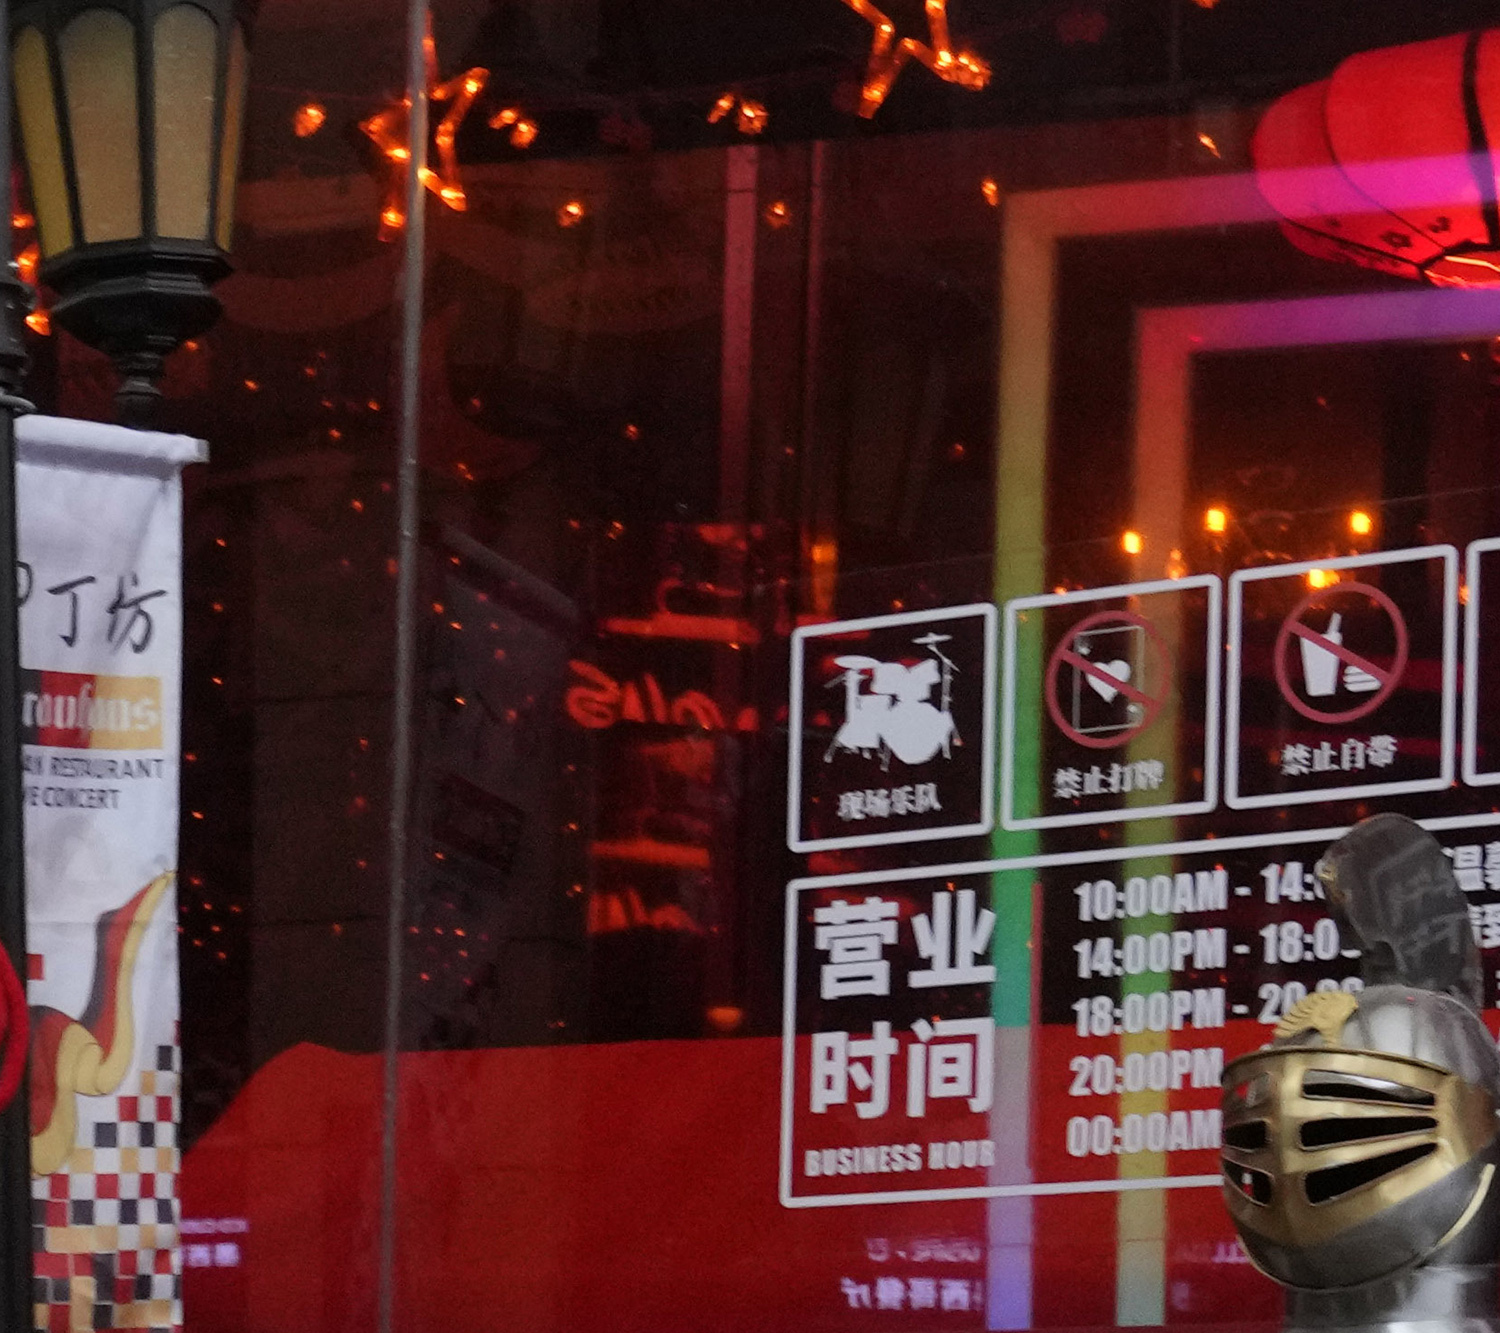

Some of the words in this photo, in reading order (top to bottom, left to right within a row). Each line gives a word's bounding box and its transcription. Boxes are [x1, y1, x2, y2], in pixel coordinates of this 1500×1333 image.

[1053, 759, 1165, 799] 禁止打牌
[1281, 734, 1398, 776] 禁止自带
[1075, 869, 1229, 922] 10:00AM
[1263, 861, 1326, 904] 14:
[814, 889, 998, 1000] 营业
[1073, 928, 1228, 980] 14:00PM
[1261, 917, 1362, 964] 18:0
[1071, 986, 1226, 1038] 18:00PM
[809, 1015, 998, 1121] 时间
[1069, 1047, 1224, 1097] 20:00PM
[1066, 1107, 1223, 1158] 00:00AM
[804, 1143, 922, 1178] BUSINESS
[928, 1140, 997, 1172] HOUR
